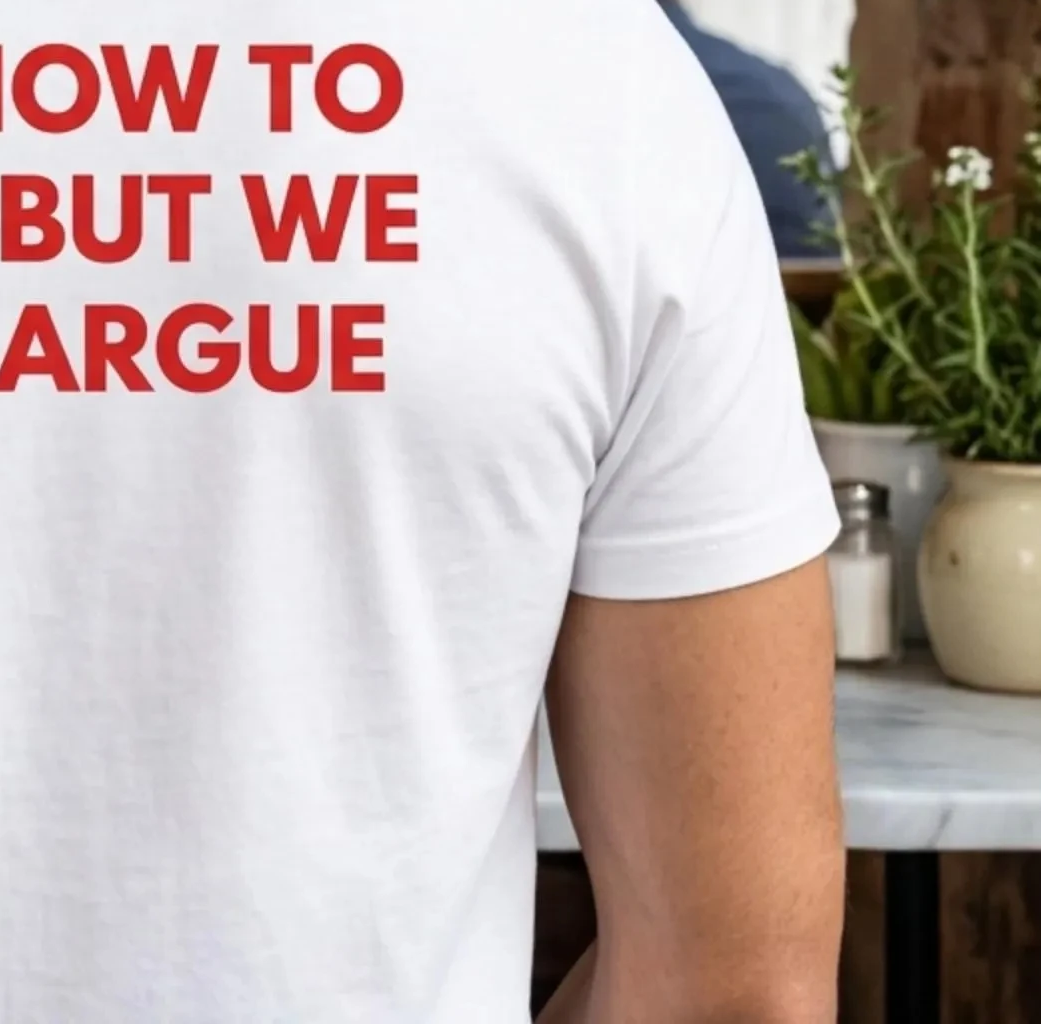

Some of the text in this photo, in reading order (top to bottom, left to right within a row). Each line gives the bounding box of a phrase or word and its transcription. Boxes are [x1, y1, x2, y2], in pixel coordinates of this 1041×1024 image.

[248, 43, 403, 133] TO
[0, 174, 212, 263] BUT
[241, 174, 418, 263] WE
